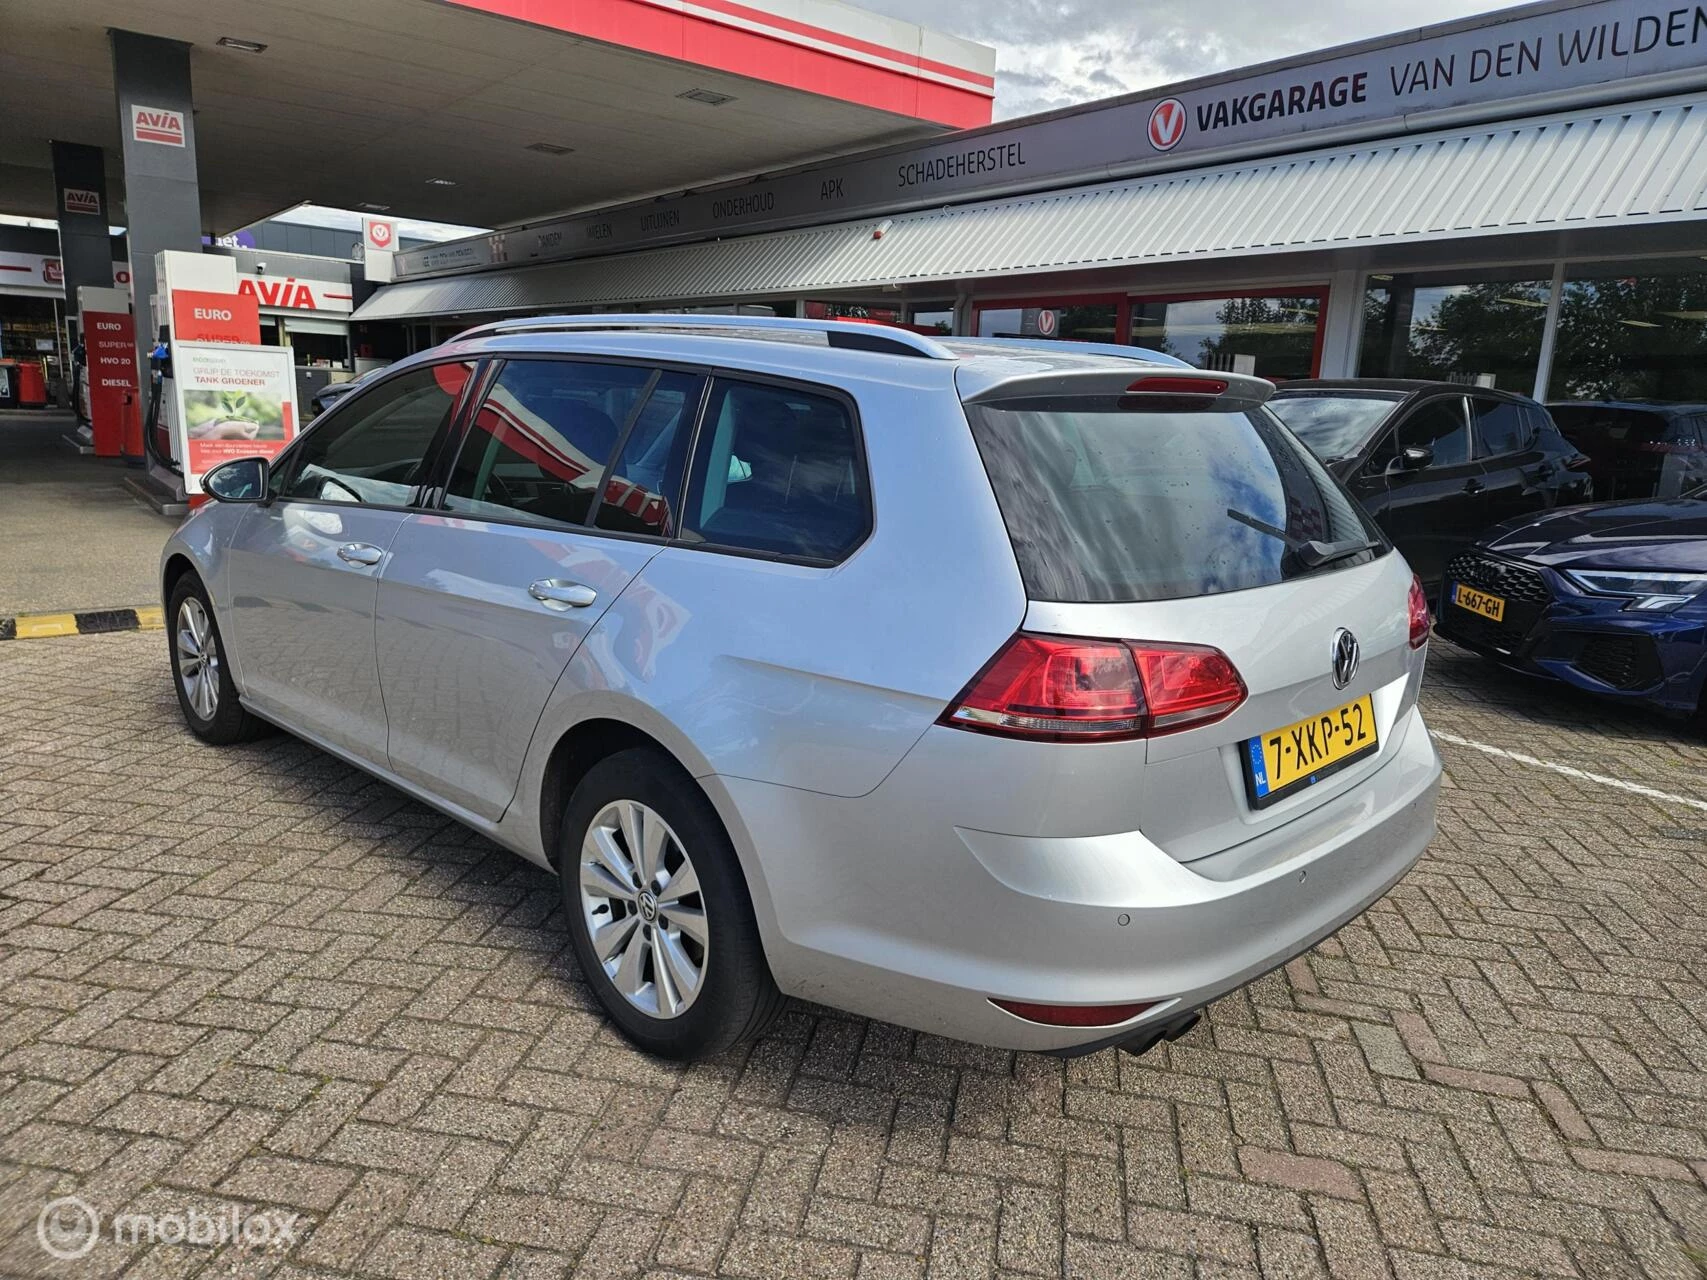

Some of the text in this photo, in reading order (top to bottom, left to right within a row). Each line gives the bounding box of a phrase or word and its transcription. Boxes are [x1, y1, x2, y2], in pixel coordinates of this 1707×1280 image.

[1197, 72, 1368, 132] VAKGARAGE
[1390, 54, 1455, 96] VAN
[1469, 37, 1542, 83] DEN
[712, 191, 775, 219] ONDERHOUD
[820, 177, 844, 201] APK
[898, 142, 1026, 188] SCHADEHERSTEL
[194, 307, 232, 320] EURO
[96, 322, 121, 331] EURO
[100, 357, 119, 365] HVO
[220, 368, 233, 376] DE
[101, 378, 131, 387] DIESEL
[195, 376, 265, 386] TANK GROENER
[1457, 587, 1501, 618] L-667-GH
[1269, 703, 1367, 780] 7-XKP-52
[1254, 771, 1267, 786] NL
